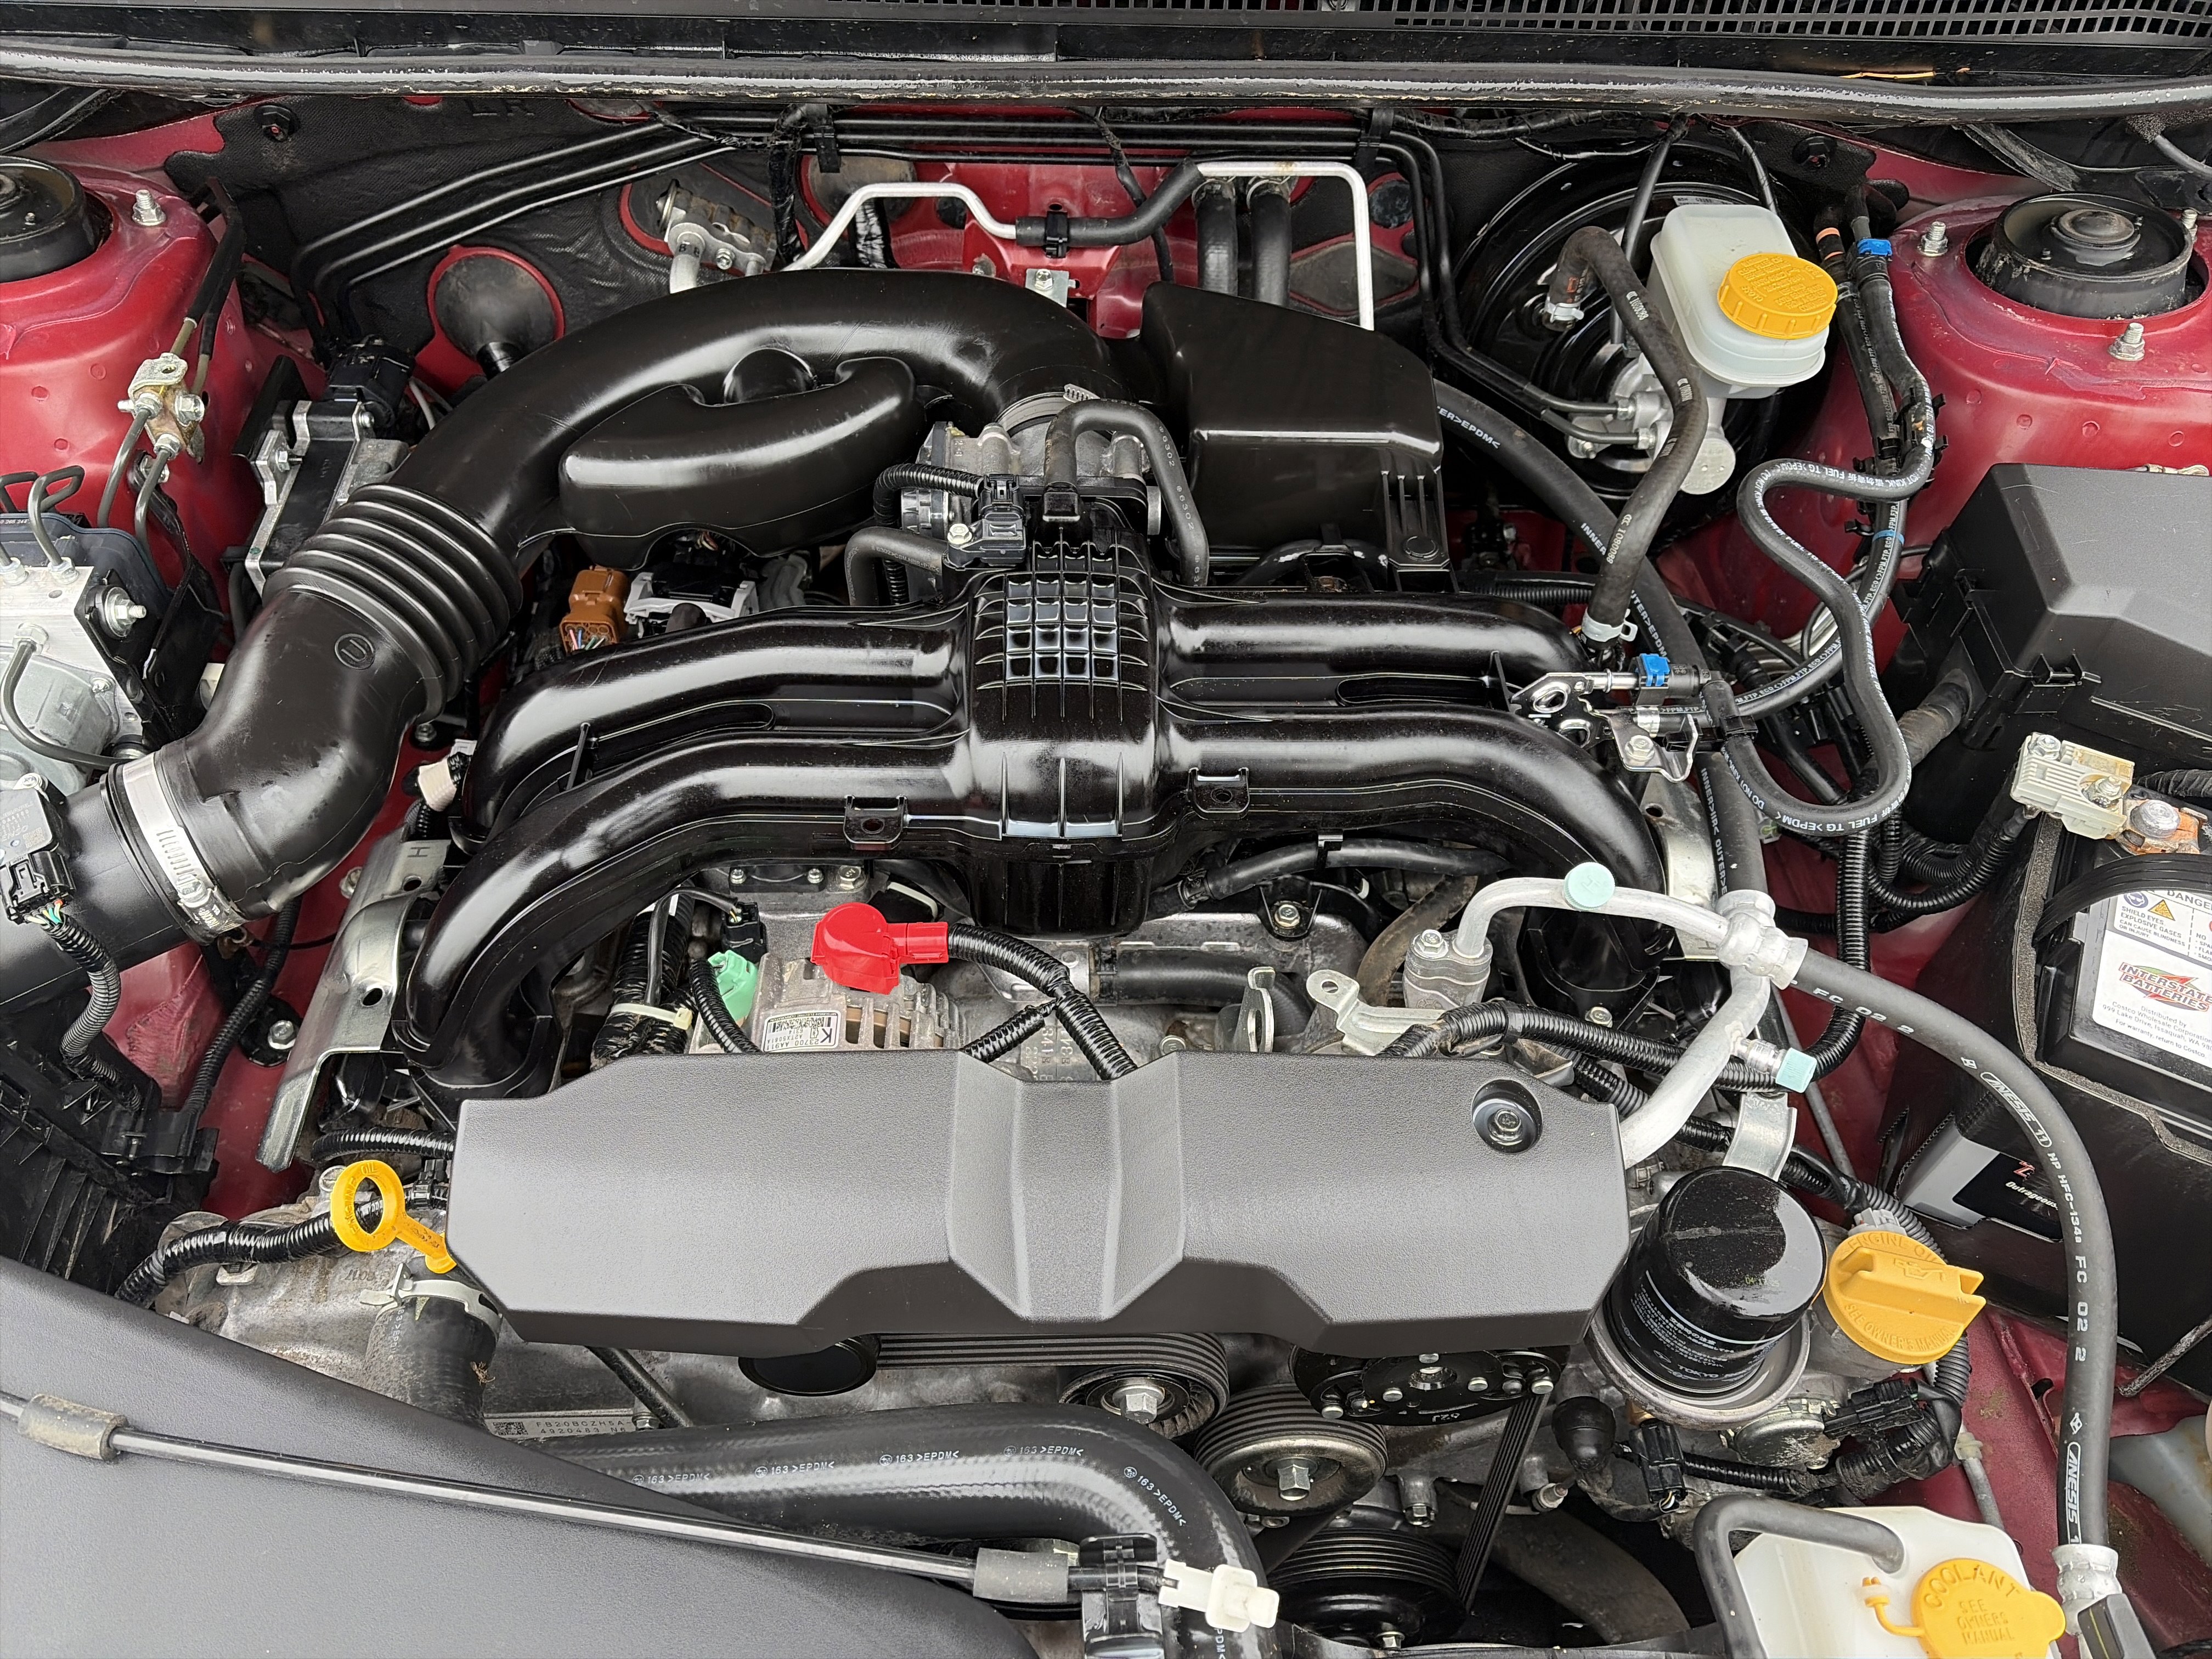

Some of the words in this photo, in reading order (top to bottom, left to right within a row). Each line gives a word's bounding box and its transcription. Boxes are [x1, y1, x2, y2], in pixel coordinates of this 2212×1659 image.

[1741, 285, 1764, 302] CLOSE
[1437, 406, 1500, 449] ER>EPDM<
[1809, 464, 1821, 474] TG
[1825, 467, 1846, 480] FUEL
[1581, 523, 1607, 556] INNER
[1739, 778, 1753, 797] NOT
[1752, 794, 1765, 811] DO
[1826, 823, 1844, 832] TG
[1848, 813, 1878, 829] FUEL
[2166, 889, 2212, 910] DANGE
[2121, 906, 2146, 918] SHIELD
[2121, 912, 2158, 930] EXPLOSIVE
[2159, 926, 2182, 938] GASES
[2133, 923, 2152, 933] CAUSE
[2153, 930, 2186, 946] BLINDNESS
[2121, 964, 2212, 1004] INTERSTATE
[2123, 974, 2207, 1011] BATTERIES
[1813, 988, 1843, 1003] FC
[1855, 1007, 1887, 1022] 02
[1898, 1025, 1914, 1034] 2
[2112, 1001, 2136, 1014] Costco
[2138, 1011, 2172, 1029] Wholesale
[2141, 1006, 2177, 1024] Distributed
[2102, 1005, 2115, 1013] 999
[2117, 1010, 2133, 1020] Lake
[2188, 1037, 2200, 1046] WA
[820, 1028, 832, 1043] K
[2155, 1035, 2174, 1046] return
[360, 1161, 378, 1175] OIL
[2047, 1152, 2062, 1170] HP
[345, 1177, 362, 1234] ENGINE
[2058, 1174, 2082, 1243] HFC-134a
[1847, 1233, 1908, 1251] ENGINE
[2075, 1255, 2087, 1283] FC
[2076, 1301, 2089, 1332] 02
[1845, 1303, 1864, 1326] SEE
[1865, 1322, 1914, 1350] OWNER'S
[1917, 1324, 1959, 1351] MANUAL
[2075, 1346, 2086, 1363] 2
[1678, 1364, 1719, 1378] TOKYO
[895, 1454, 914, 1463] 163
[917, 1451, 960, 1462] >EPDM<
[1019, 1446, 1037, 1454] 163
[1040, 1446, 1085, 1457] >EPDM<
[771, 1466, 789, 1475] 163
[792, 1461, 836, 1472] >EPDM<
[647, 1475, 665, 1484] 163
[668, 1472, 710, 1482] >EPDM<
[1137, 1475, 1154, 1491] 163
[1153, 1488, 1187, 1527] >EPDM<
[1923, 1564, 2020, 1608] COOLANT
[1959, 1599, 1988, 1613] SEE
[1957, 1611, 2009, 1630] OWNERS
[1962, 1627, 2016, 1645] MANUAL
